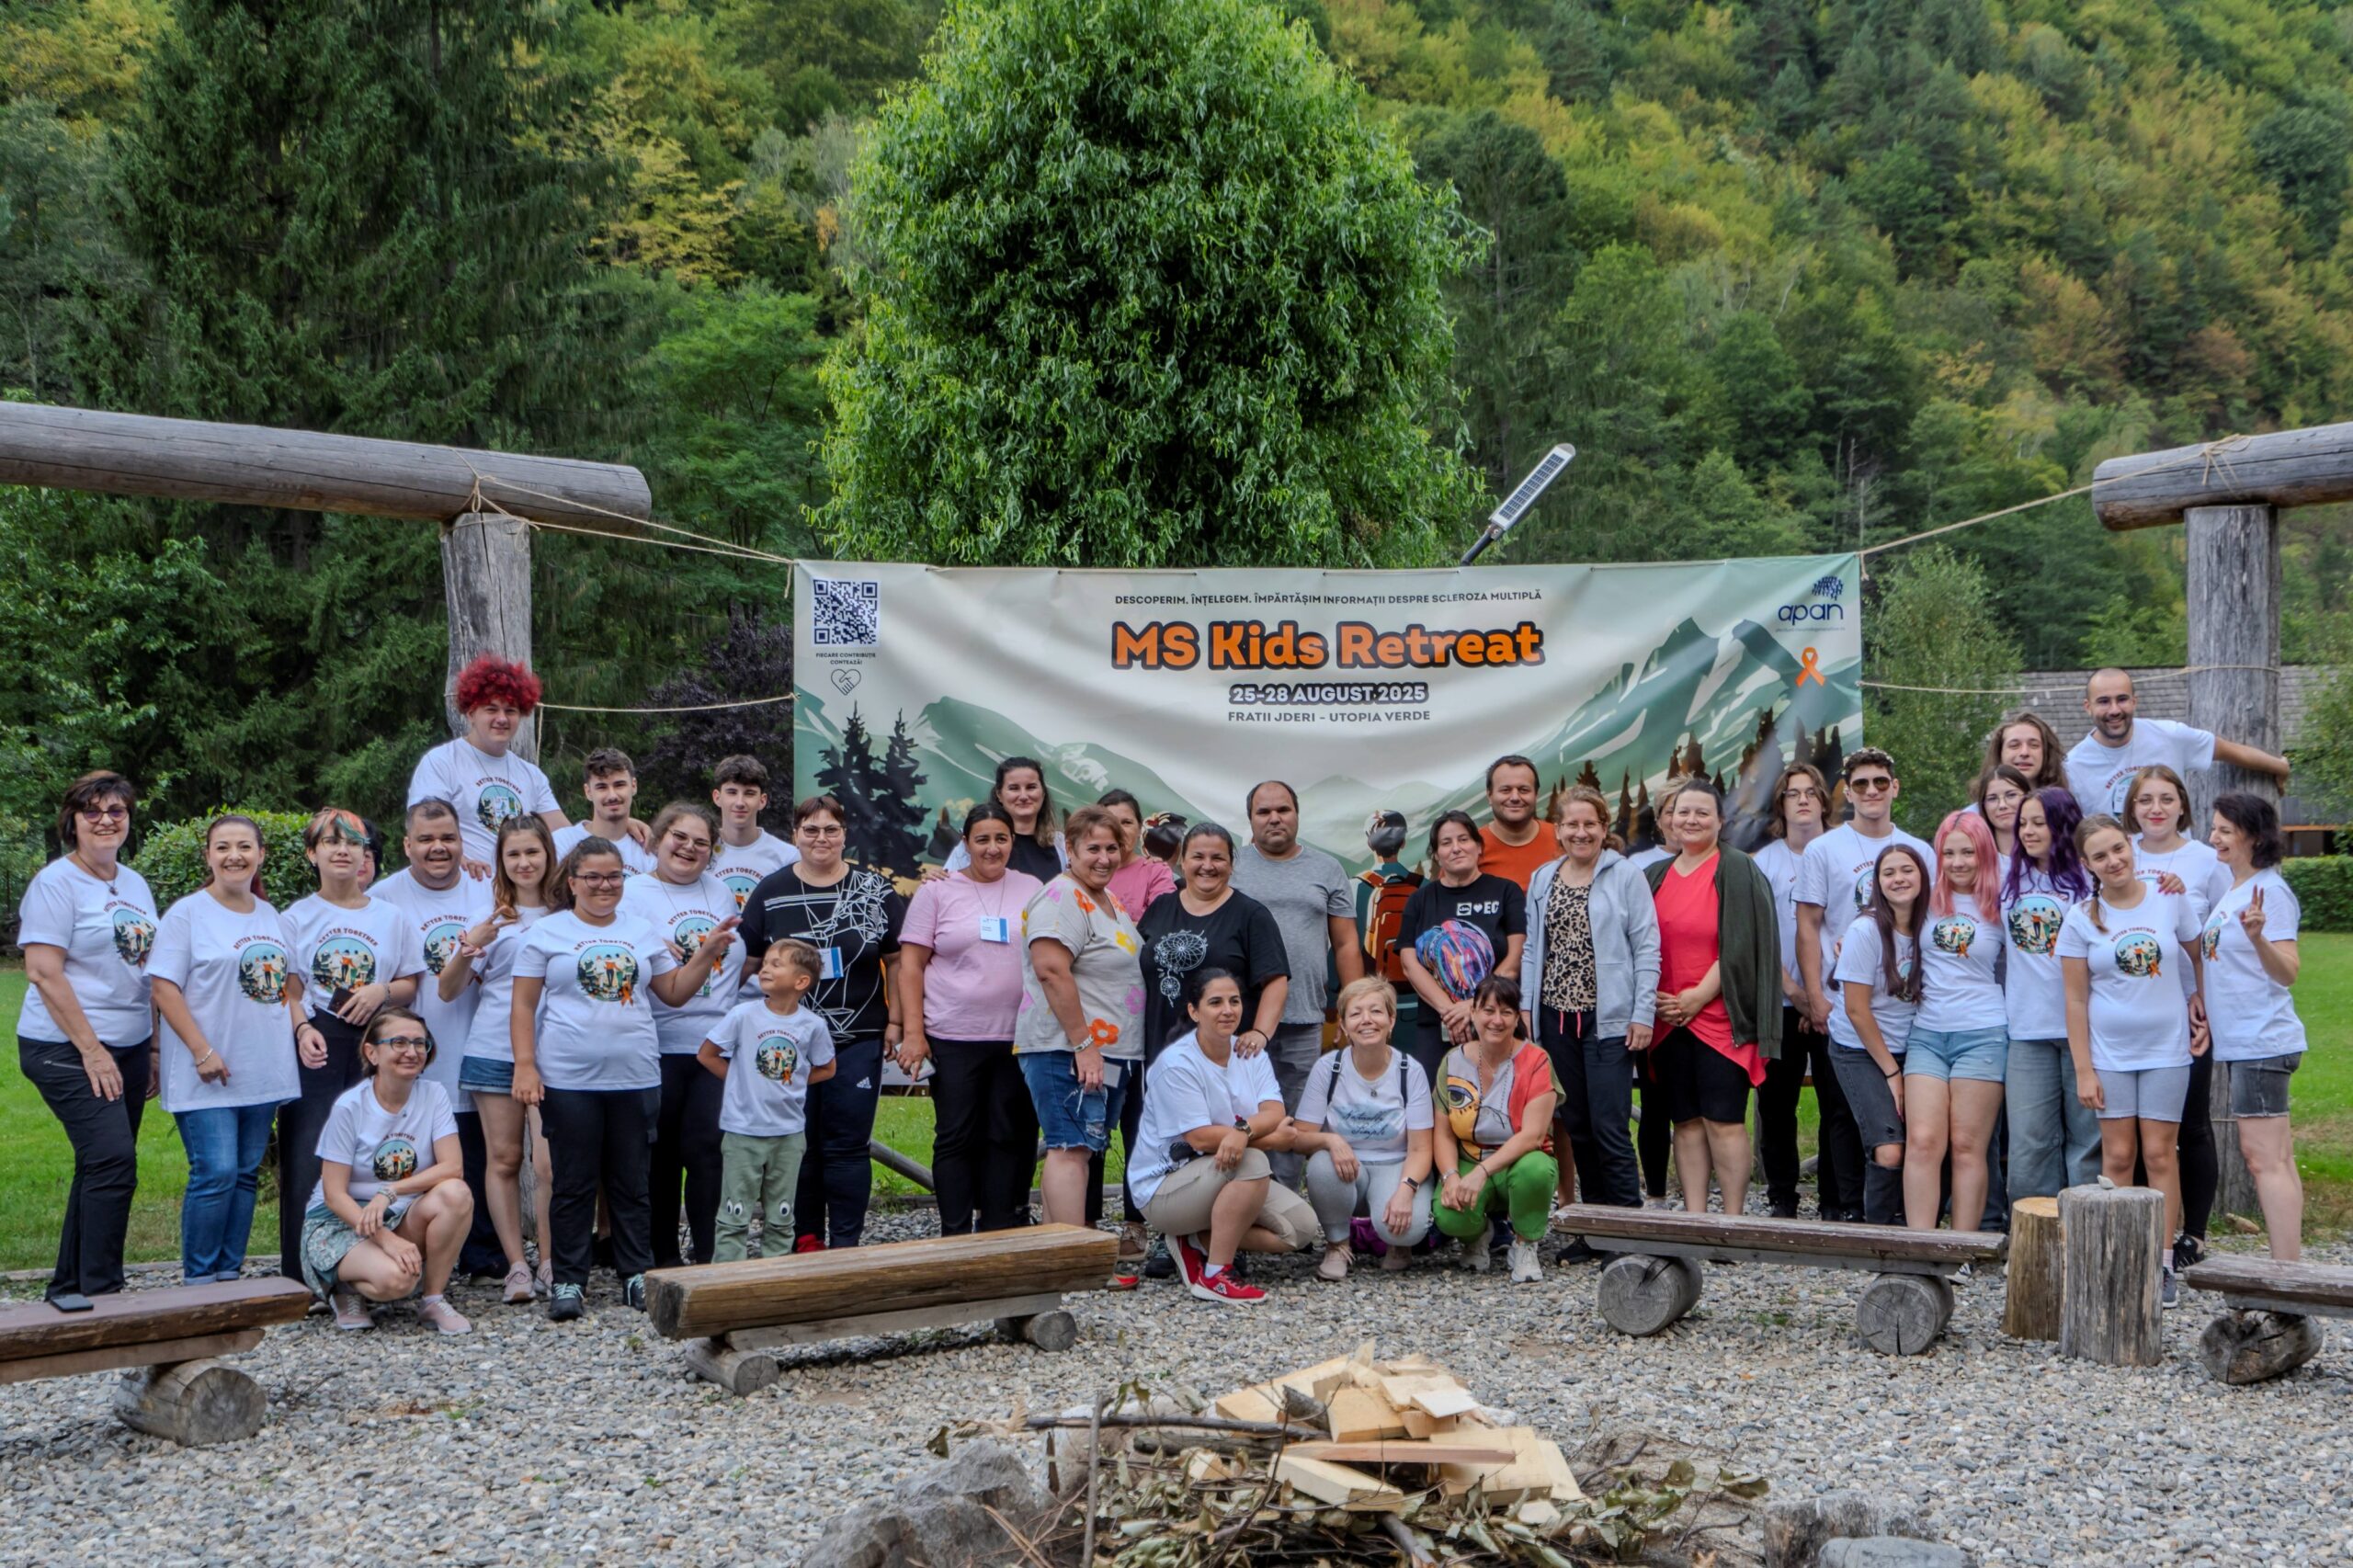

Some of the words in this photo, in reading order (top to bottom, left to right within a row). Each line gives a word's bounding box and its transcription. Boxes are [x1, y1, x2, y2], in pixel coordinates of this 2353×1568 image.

[1115, 596, 1188, 605] DESCOPERIM.
[1324, 596, 1385, 607] INFORMAȚII
[1389, 595, 1429, 604] DESPRE
[1432, 593, 1488, 603] SCLEROZA
[1490, 589, 1542, 601] MULTIPLĂ
[1778, 603, 1844, 626] apan
[1113, 623, 1198, 669] MS
[1211, 622, 1326, 669] Kids
[1338, 622, 1542, 668] Retreat
[1232, 687, 1289, 702] 25-28
[1293, 686, 1373, 702] AUGUST
[1379, 685, 1426, 701] 2025
[1228, 711, 1270, 722] FRATII
[1275, 711, 1315, 722] JDERI
[1329, 711, 1382, 722] UTOPIA
[1385, 710, 1430, 722] VERDE
[715, 868, 733, 878] ETTER
[735, 868, 765, 880] TOGETHE
